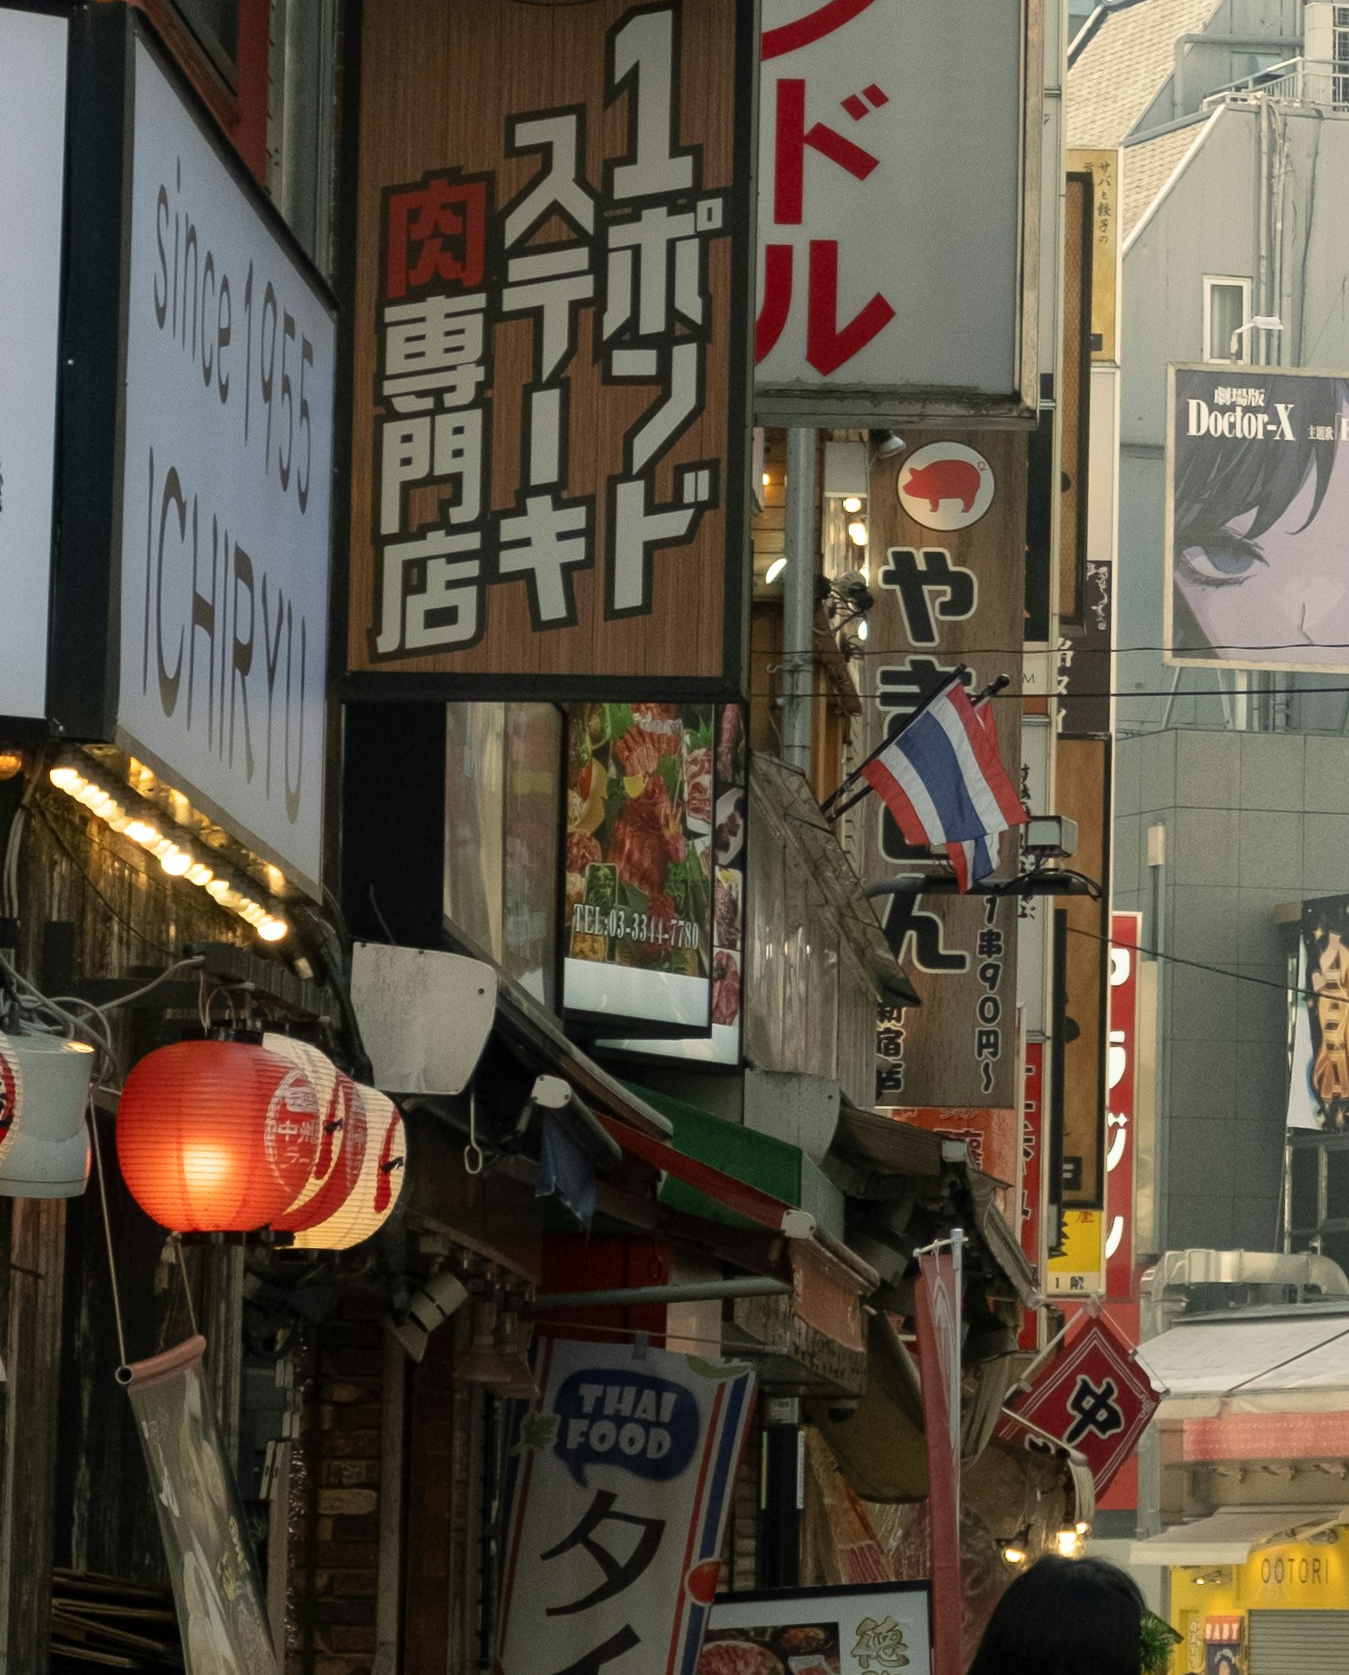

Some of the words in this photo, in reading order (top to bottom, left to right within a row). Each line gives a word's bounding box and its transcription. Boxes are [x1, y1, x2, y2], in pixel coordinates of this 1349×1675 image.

[152, 155, 233, 409] since
[243, 256, 312, 515] 1955
[378, 180, 487, 655] 肉専門店
[500, 113, 595, 625] ステーキ
[1186, 398, 1297, 442] Doctor-X
[144, 442, 309, 827] ICHIRYU
[572, 901, 700, 952] TEL:03-3344-7780
[564, 1414, 672, 1461] FOOD
[577, 1380, 677, 1424] THAI
[1260, 1556, 1330, 1585] OOTORI
